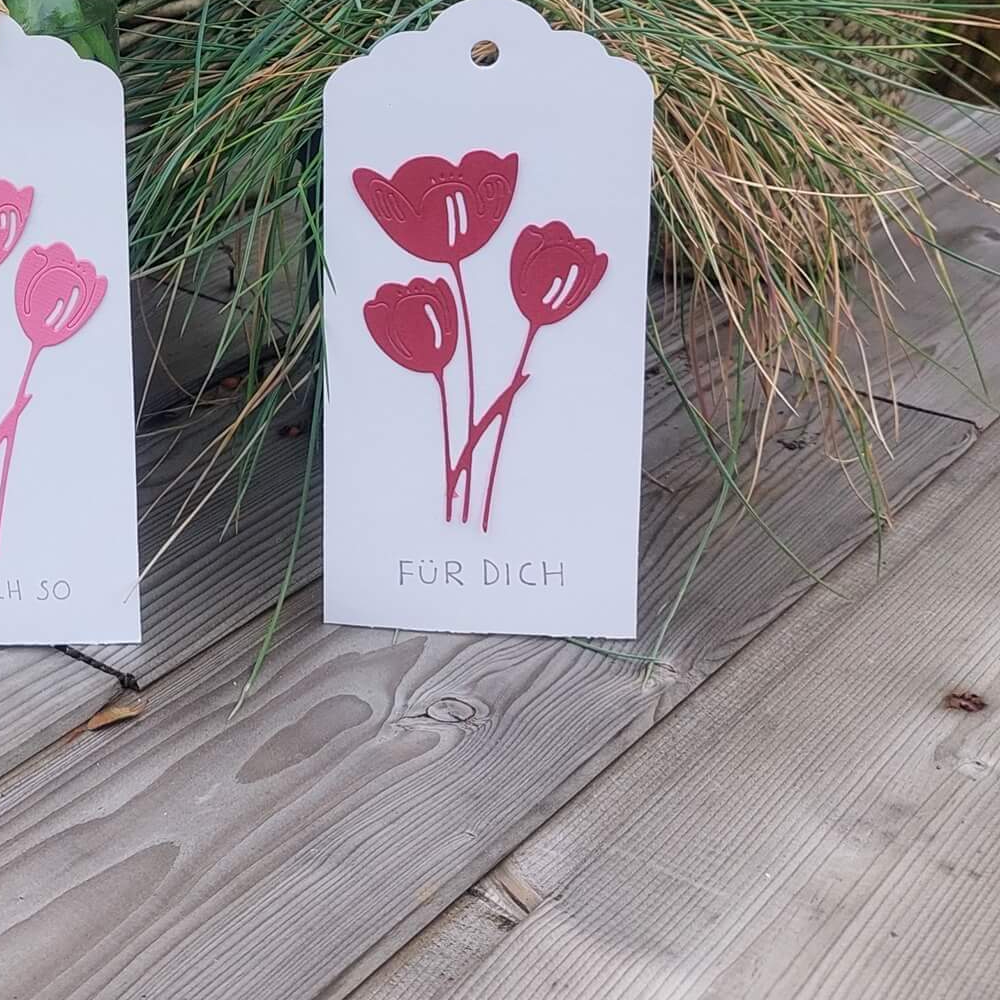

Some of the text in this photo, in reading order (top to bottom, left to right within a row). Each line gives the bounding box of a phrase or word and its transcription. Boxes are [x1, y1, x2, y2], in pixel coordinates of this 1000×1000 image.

[399, 558, 565, 587] FÜR DICH
[36, 579, 71, 601] SO
